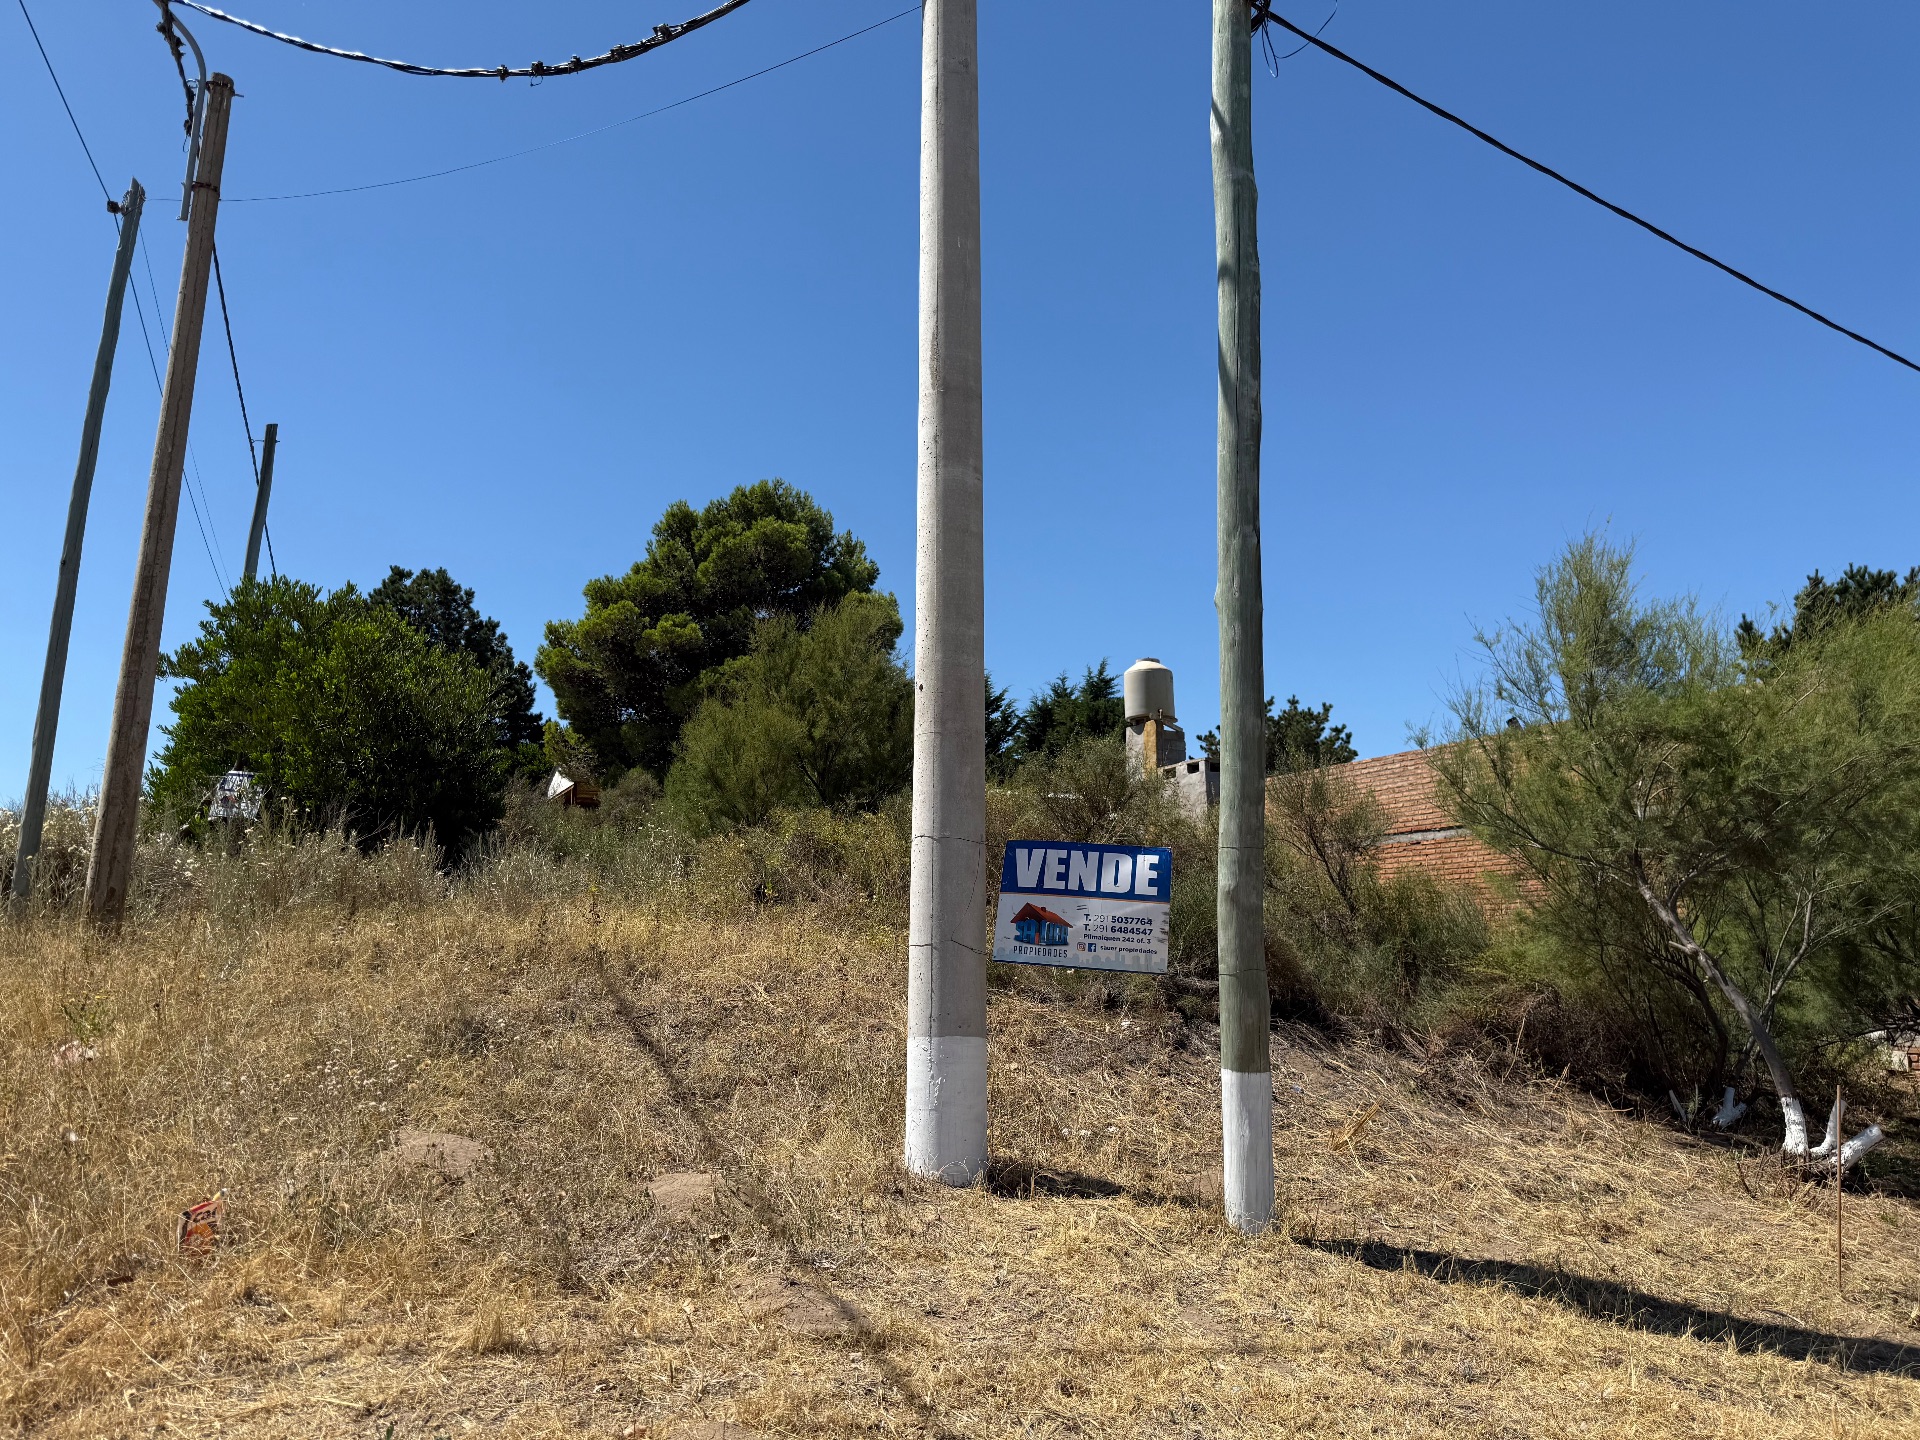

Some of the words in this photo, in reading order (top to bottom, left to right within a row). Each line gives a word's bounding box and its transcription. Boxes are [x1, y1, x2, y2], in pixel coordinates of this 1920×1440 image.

[1015, 848, 1160, 896] VENDE
[1084, 914, 1091, 922] T.
[1111, 915, 1152, 925] 5037764
[1083, 923, 1091, 931] T.
[1093, 924, 1108, 932] 291
[1110, 926, 1153, 935] 6484547
[1013, 945, 1068, 958] PROPIEDADES
[1118, 946, 1157, 954] propiedades
